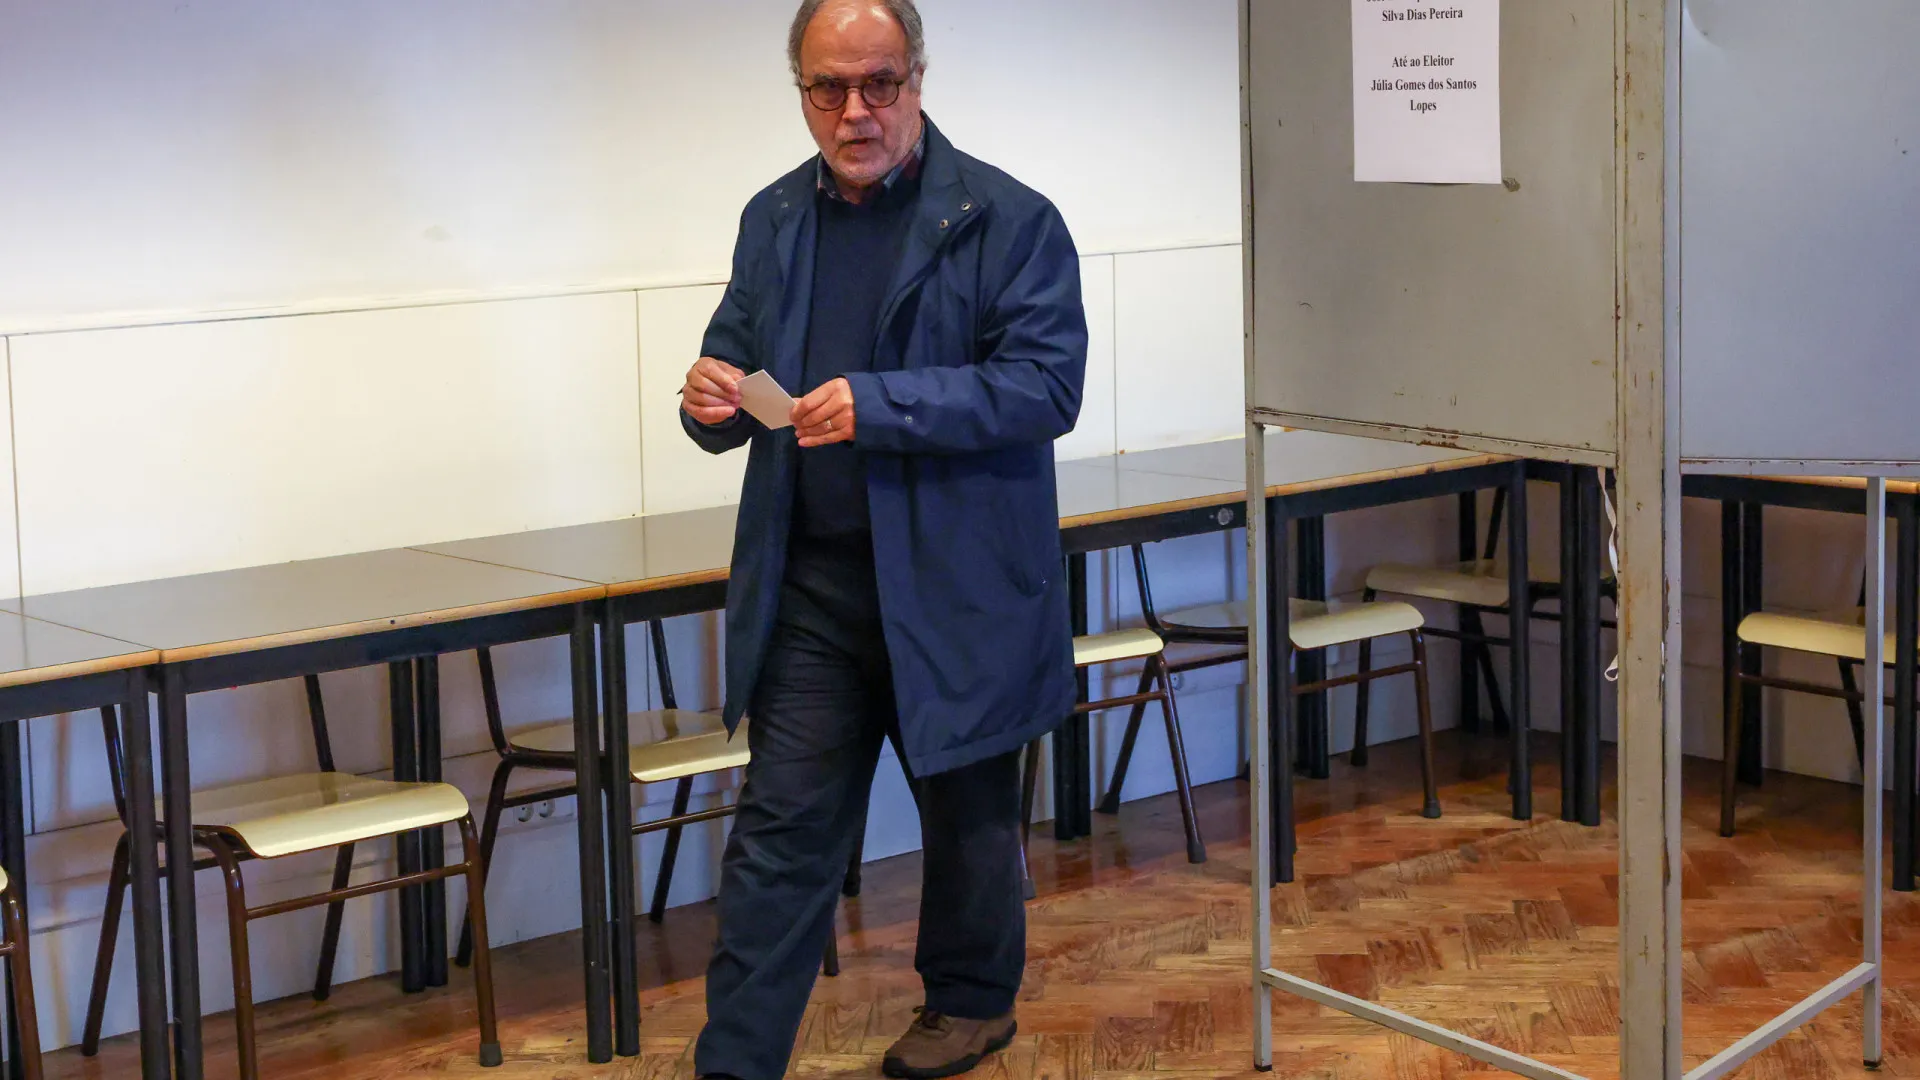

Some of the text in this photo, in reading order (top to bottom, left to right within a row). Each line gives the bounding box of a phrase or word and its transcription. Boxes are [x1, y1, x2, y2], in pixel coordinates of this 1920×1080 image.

[1382, 7, 1463, 21] Silva Dias Pereira
[1392, 55, 1454, 67] Até ao Eleitor
[1371, 78, 1477, 91] Júlia Gomes dos Santos
[1410, 100, 1437, 113] Lopes
